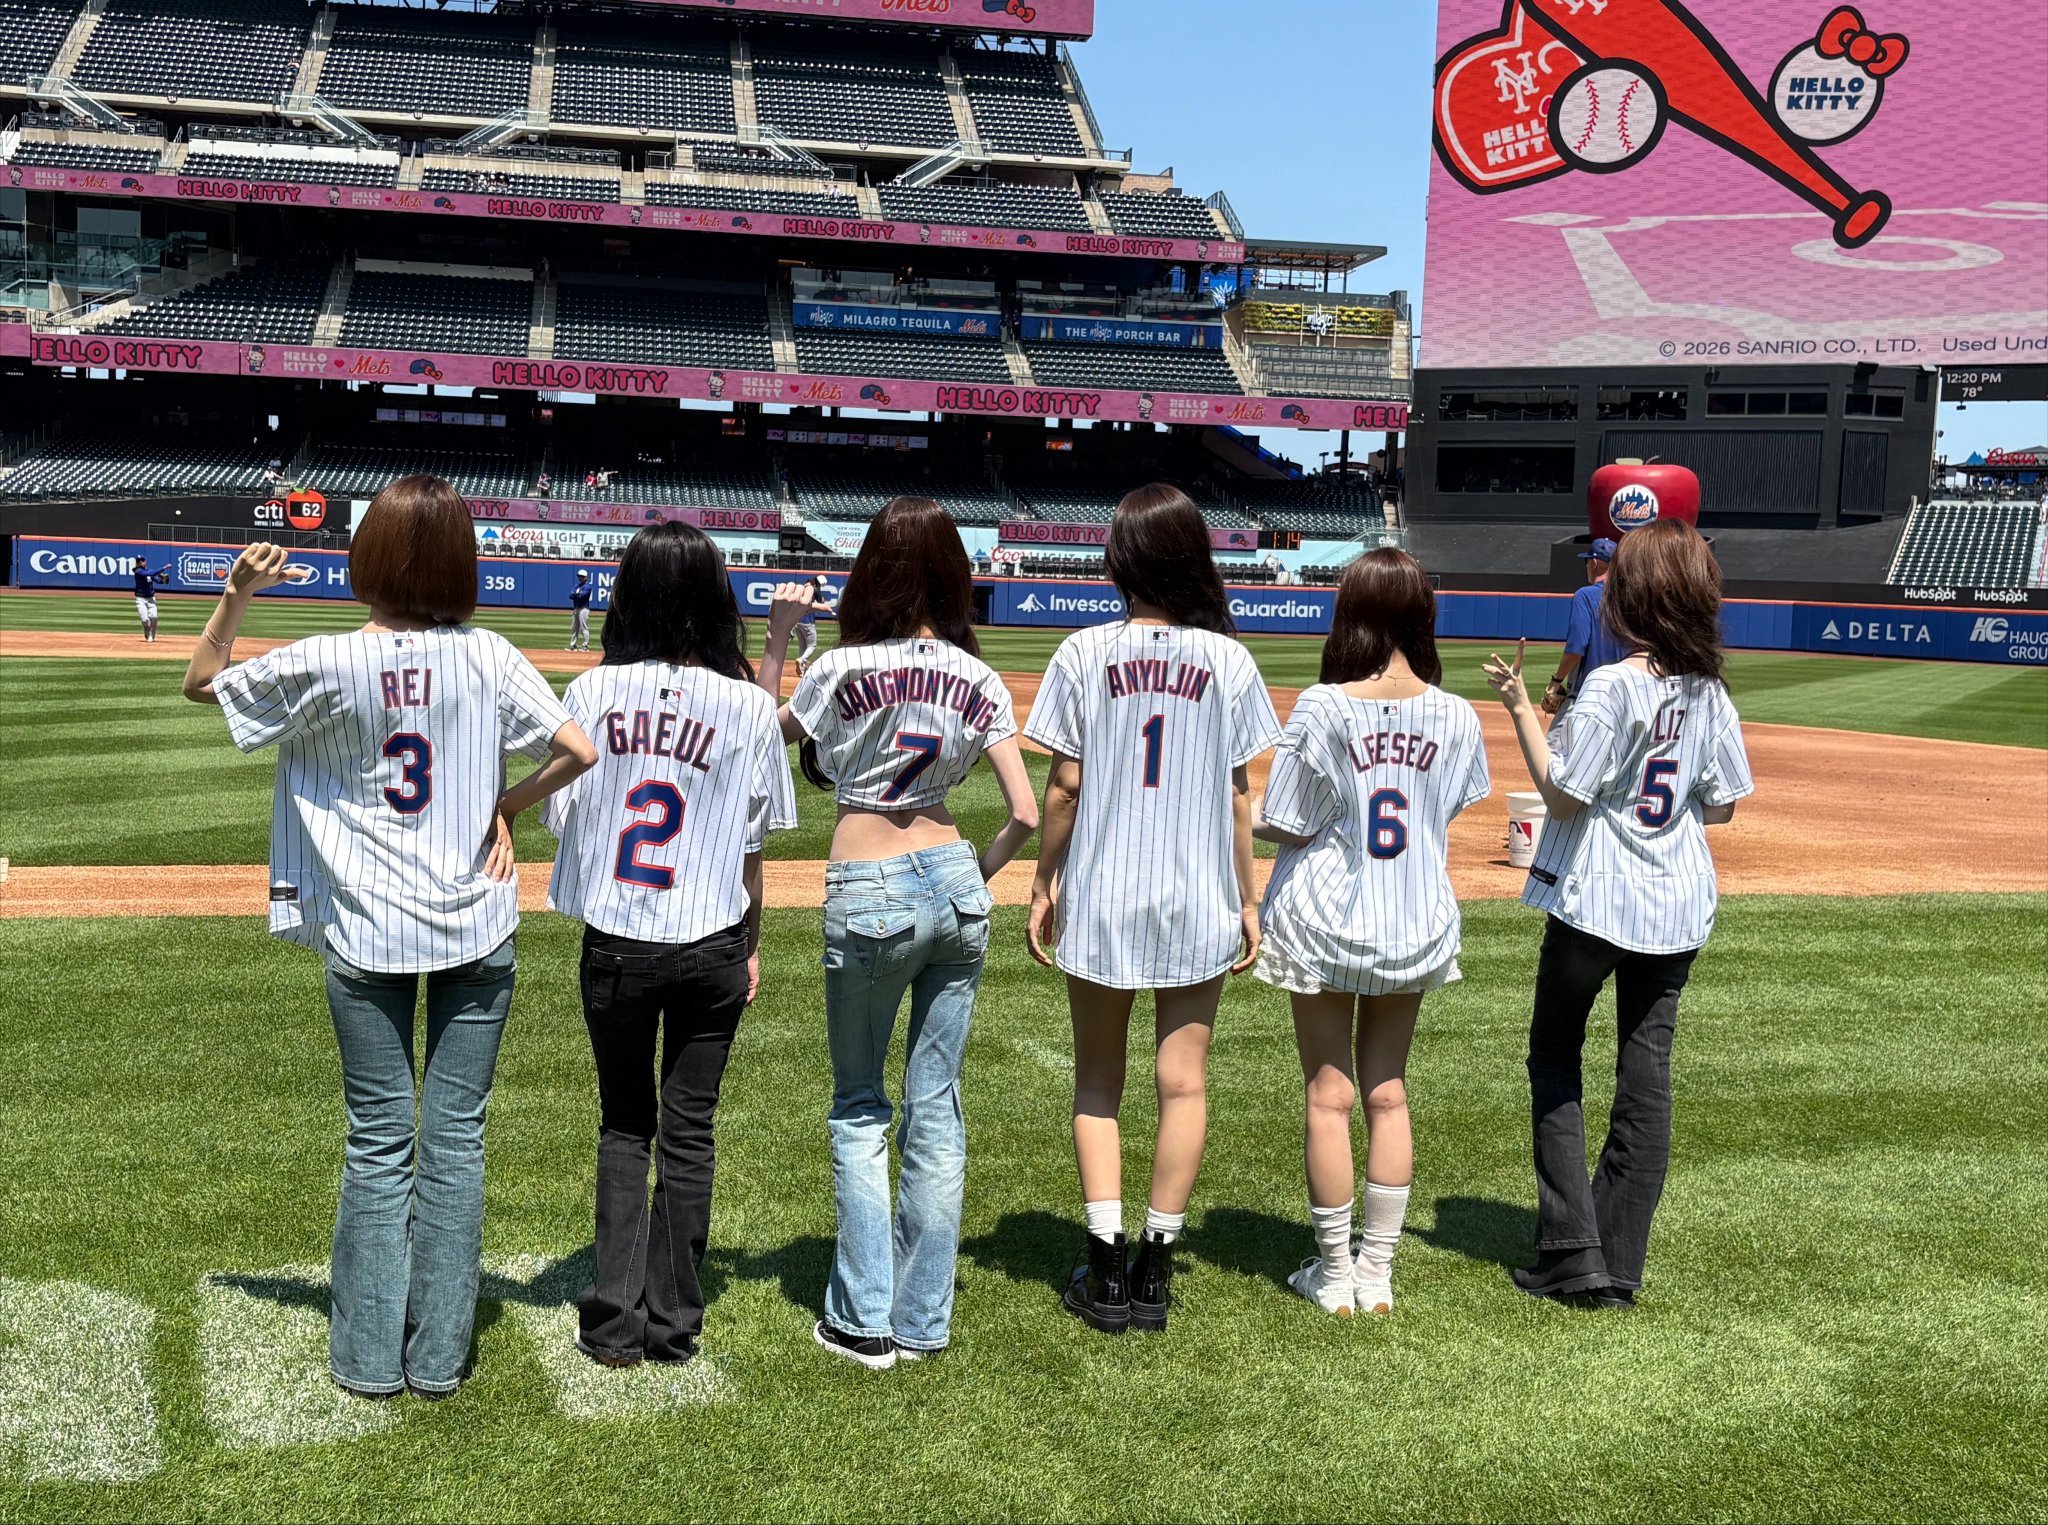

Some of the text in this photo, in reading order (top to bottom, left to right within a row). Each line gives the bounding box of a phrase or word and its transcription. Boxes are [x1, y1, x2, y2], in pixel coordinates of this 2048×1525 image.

[1789, 76, 1865, 94] HELLO
[1786, 94, 1862, 111] KITTY
[1483, 119, 1549, 149] HELL
[1486, 134, 1549, 167] KITT
[35, 171, 65, 180] HELLO
[35, 178, 65, 187] KITTY
[79, 175, 110, 189] Mets
[178, 180, 301, 202] HELLO KITTY
[352, 192, 381, 200] HELLO
[352, 197, 381, 206] KITTY
[392, 194, 423, 209] Mets
[488, 199, 604, 221] HELLO KITTY
[653, 210, 681, 218] HELLO
[653, 217, 681, 226] KITTY
[692, 213, 720, 227] Mets
[783, 218, 895, 241] HELLO KITTY
[1066, 236, 1173, 257] HELLO KITTY
[843, 314, 951, 330] MILAGRO TEQUILA
[959, 319, 987, 334] Mets
[1065, 327, 1087, 338] THE
[1115, 330, 1153, 341] PORCH
[1157, 332, 1180, 342] BAR
[1683, 341, 1731, 356] 2026
[1736, 339, 1817, 355] SANRIO
[1823, 339, 1867, 356] CO.,
[1875, 339, 1921, 353] LTD.
[1942, 337, 1997, 352] Used
[115, 342, 202, 369] KITTY
[283, 351, 328, 363] HELLO
[283, 361, 328, 374] KITTY
[347, 354, 391, 377] Mets
[493, 362, 669, 394] HELLO KITTY
[742, 376, 783, 388] HELLO
[1946, 372, 2002, 384] 12:20 PM
[742, 386, 783, 398] KITTY
[802, 381, 843, 401] Mets
[1961, 386, 1983, 398] 78°
[936, 386, 1100, 417] HELLO KITTY
[1169, 398, 1208, 409] HELLO
[1169, 408, 1208, 419] KITTY
[1226, 401, 1265, 421] Mets
[1987, 447, 2037, 465] Coors
[254, 502, 284, 519] citi
[302, 503, 321, 517] 62
[467, 501, 510, 517] ITTY
[561, 504, 591, 512] HELLO
[561, 511, 591, 520] KITTY
[605, 508, 633, 521] Mets
[1615, 502, 1650, 519] Mets
[700, 511, 758, 529] HELLO
[500, 524, 545, 542] Coors
[547, 531, 586, 544] LIGHT
[1053, 526, 1105, 543] KITTY
[1273, 531, 1301, 549] 1:14
[834, 537, 864, 549] Chill
[29, 550, 136, 576] Canon
[485, 576, 515, 591] 358
[1905, 587, 1957, 602] HubSpot
[1974, 589, 2028, 604] HubSpot
[1050, 594, 1122, 613] Invesco
[1229, 598, 1321, 619] Guardian
[1848, 621, 1931, 643] DELTA
[2009, 631, 2048, 645] HAUG
[2008, 645, 2048, 660] GROU
[380, 668, 433, 710] REI
[1106, 658, 1211, 703] ANYUJIN
[835, 667, 998, 734] JANGWONYONG
[1653, 709, 1686, 741] LIZ
[606, 709, 716, 773] GAEUL
[1142, 714, 1165, 788] 1
[1347, 732, 1439, 774] LEESEO
[383, 732, 433, 814] 3
[880, 731, 943, 803] 7
[1635, 758, 1680, 829] 5
[1367, 788, 1409, 860] 6
[614, 779, 686, 890] 2
